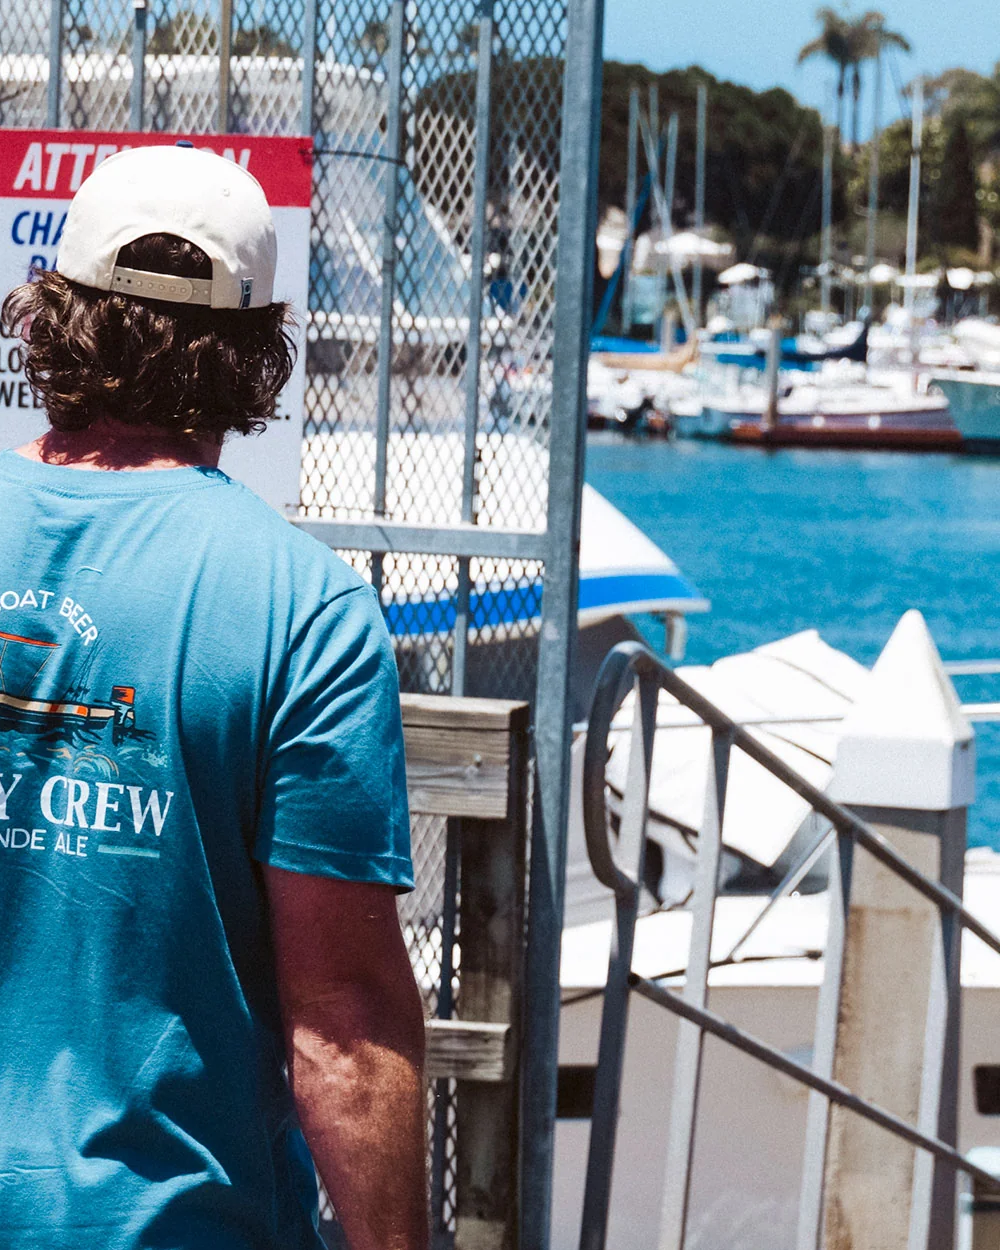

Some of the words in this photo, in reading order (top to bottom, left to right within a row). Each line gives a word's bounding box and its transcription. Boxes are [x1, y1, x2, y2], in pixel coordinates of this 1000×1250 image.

[58, 596, 99, 646] BEER
[40, 775, 174, 837] CREW
[54, 835, 88, 857] ALE
